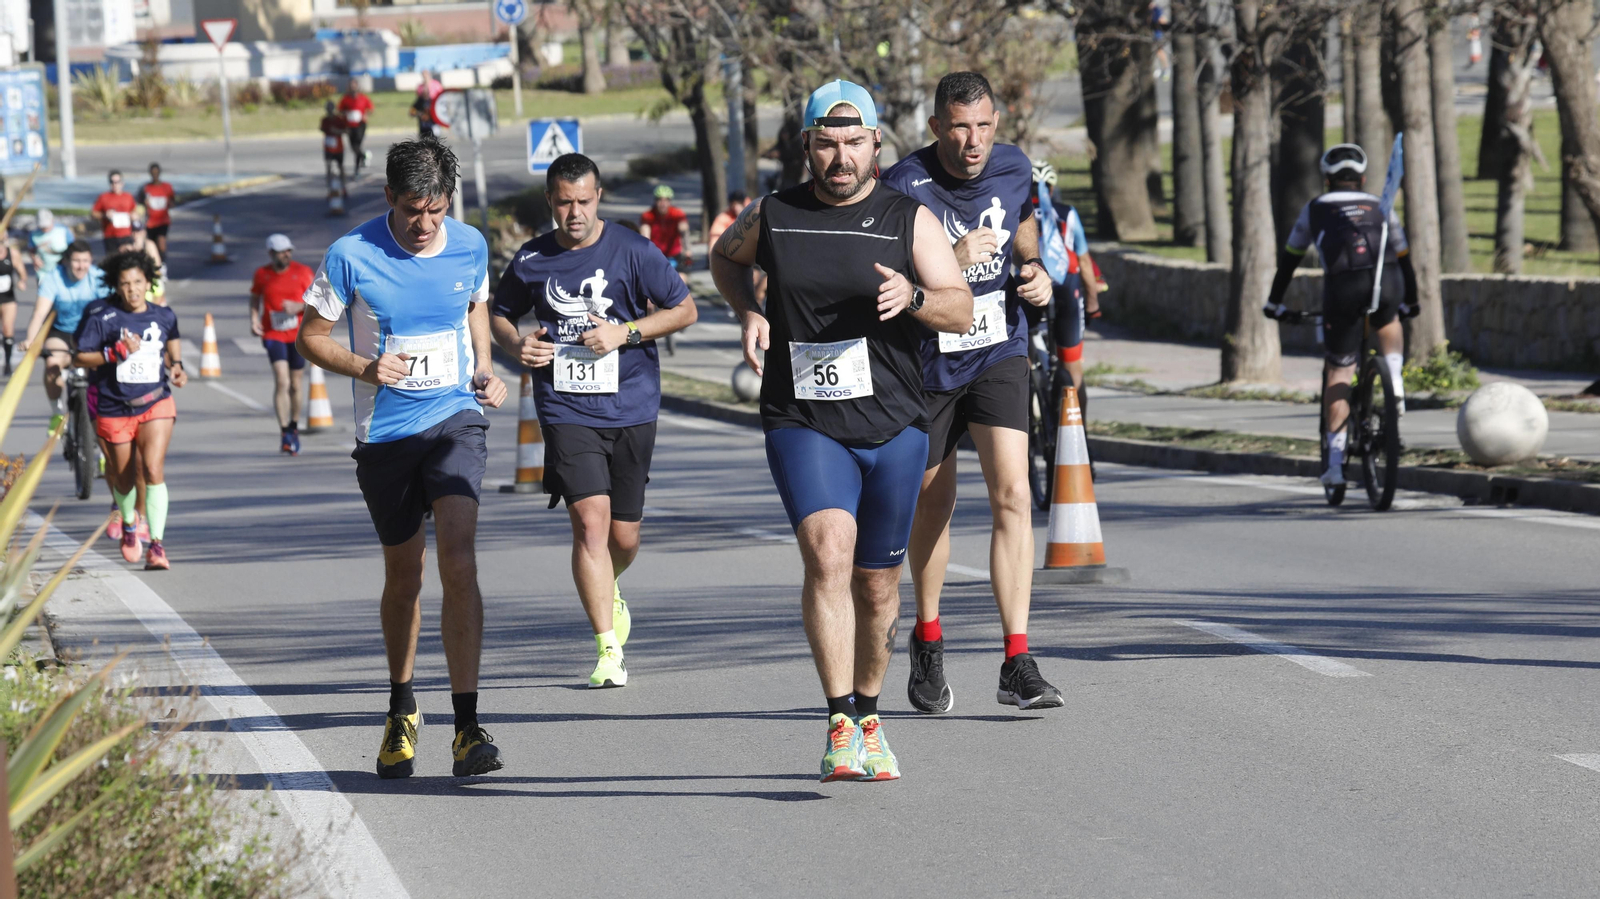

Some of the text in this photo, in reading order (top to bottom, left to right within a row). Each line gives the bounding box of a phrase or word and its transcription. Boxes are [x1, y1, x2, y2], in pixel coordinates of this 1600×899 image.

[959, 336, 992, 348] EVOS
[130, 362, 144, 375] 85
[405, 355, 428, 377] 71
[566, 362, 595, 381] 131
[813, 364, 839, 386] 56
[405, 378, 441, 388] EVOS
[814, 389, 852, 398] EVOS
